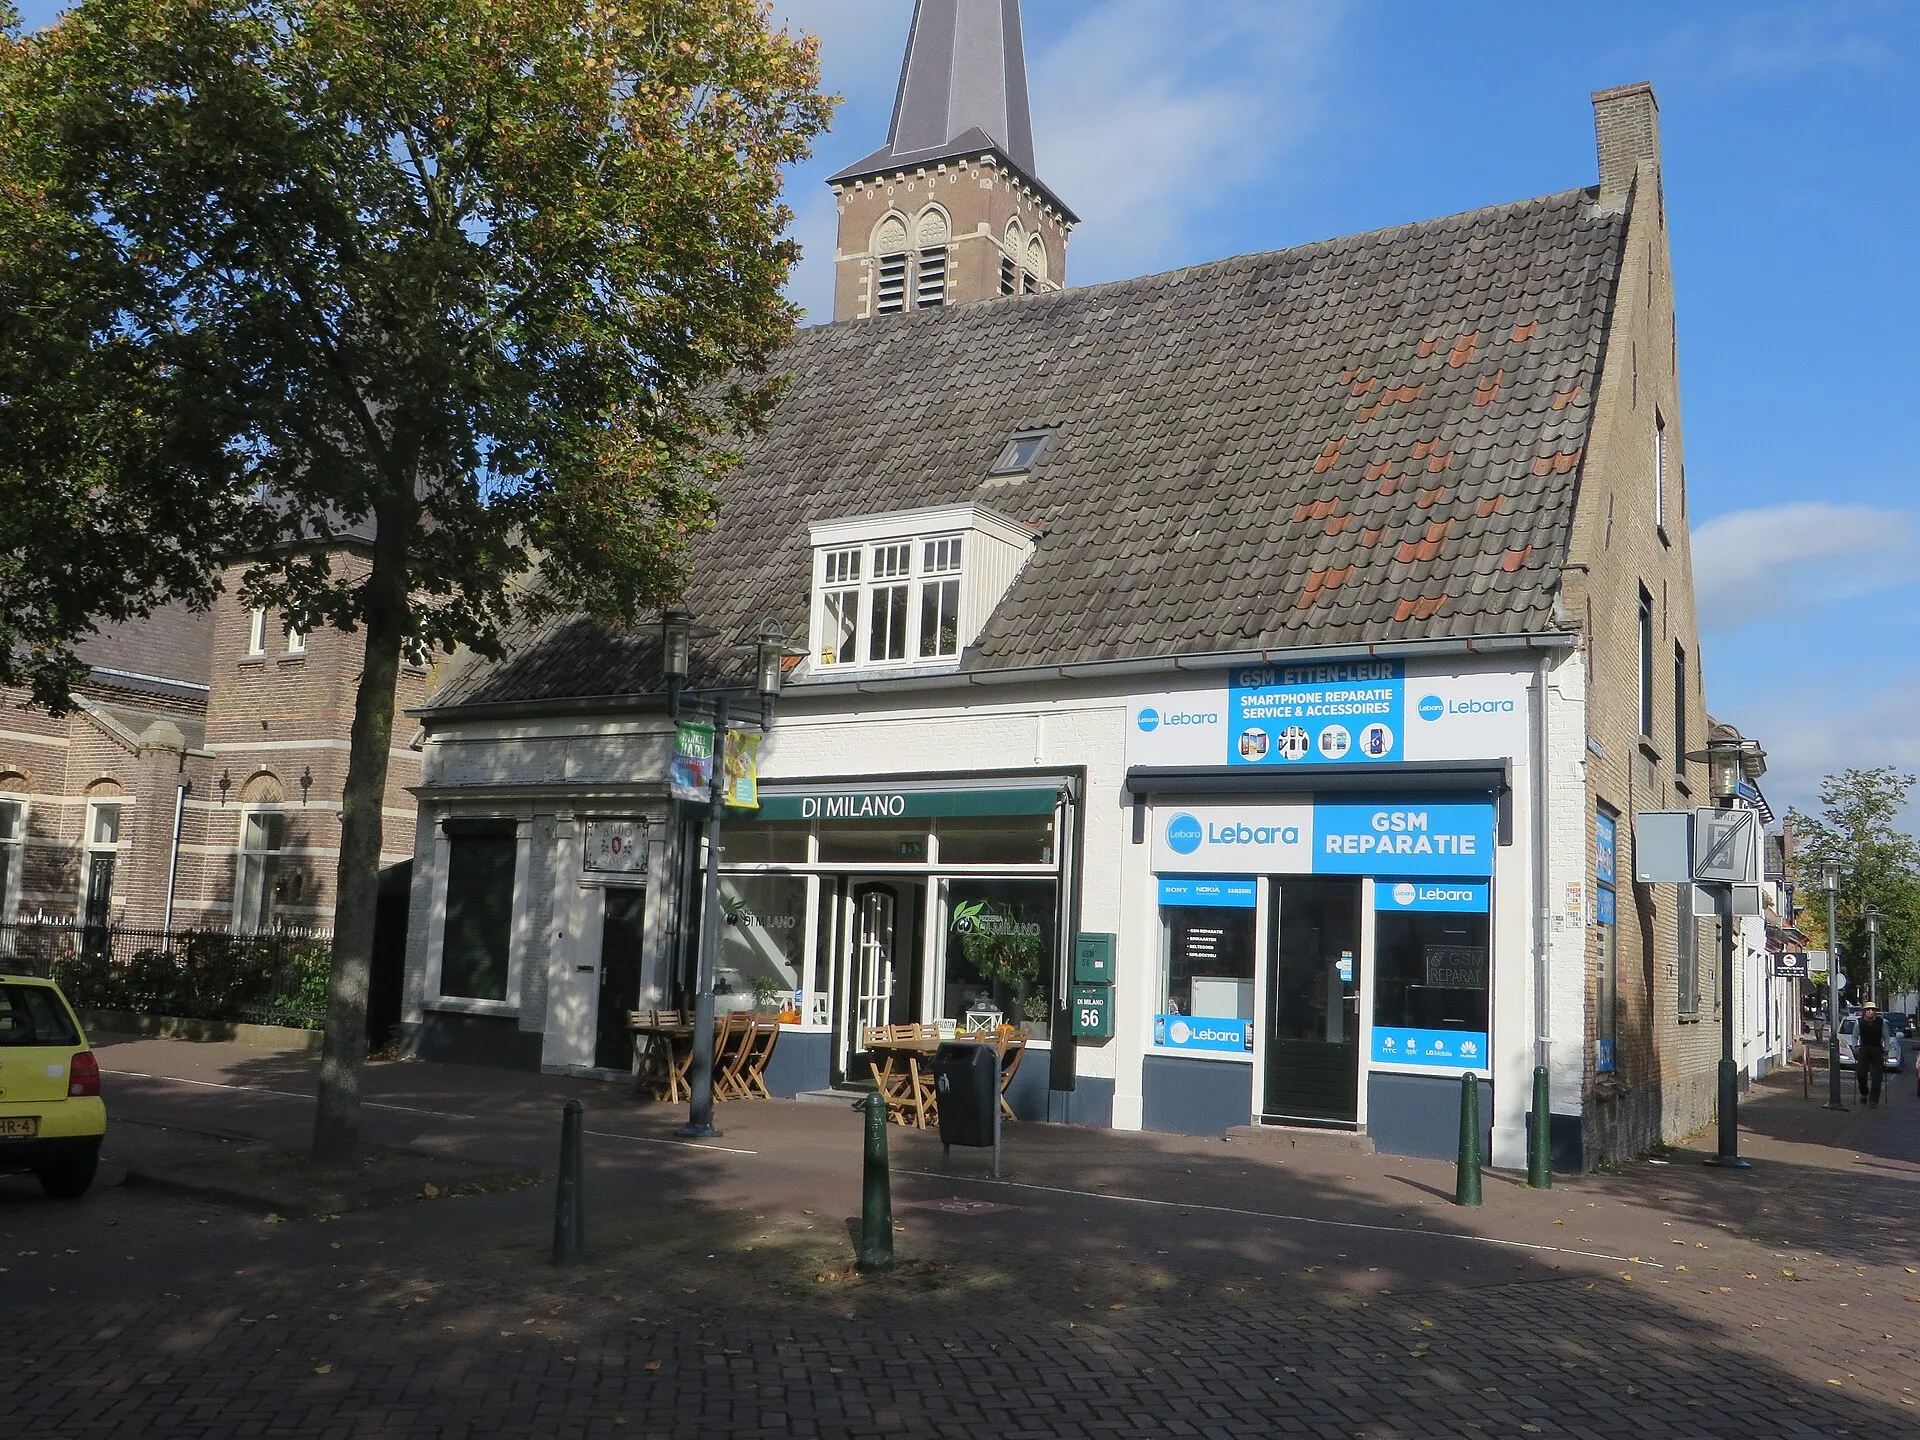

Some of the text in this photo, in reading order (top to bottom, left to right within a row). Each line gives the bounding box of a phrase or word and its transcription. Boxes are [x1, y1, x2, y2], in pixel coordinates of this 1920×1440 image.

[1240, 663, 1393, 687] GSM ETTEN-LEUR
[1240, 688, 1393, 707] SMARTPHONE REPARATIE
[1242, 702, 1390, 719] SERVICE & ACCESSOIRES
[1418, 703, 1444, 712] Lebara
[1449, 699, 1514, 714] Lebara
[1138, 715, 1159, 724] Lebara
[1163, 711, 1218, 726] Lebara
[680, 742, 707, 759] HART
[802, 795, 905, 818] DI MILANO
[1371, 812, 1428, 832] GSM
[1711, 813, 1737, 822] ZONE
[603, 825, 632, 838] anno
[1169, 830, 1201, 839] Lebara
[1208, 822, 1299, 845] Lebara
[1325, 834, 1476, 855] REPARATIE
[1419, 887, 1473, 901] Lebara
[1081, 950, 1095, 958] GSM
[1449, 952, 1484, 966] GSM
[1081, 959, 1090, 967] 56
[1083, 998, 1104, 1006] MILANO
[1080, 1009, 1099, 1027] 56
[1192, 1027, 1240, 1042] Lebara
